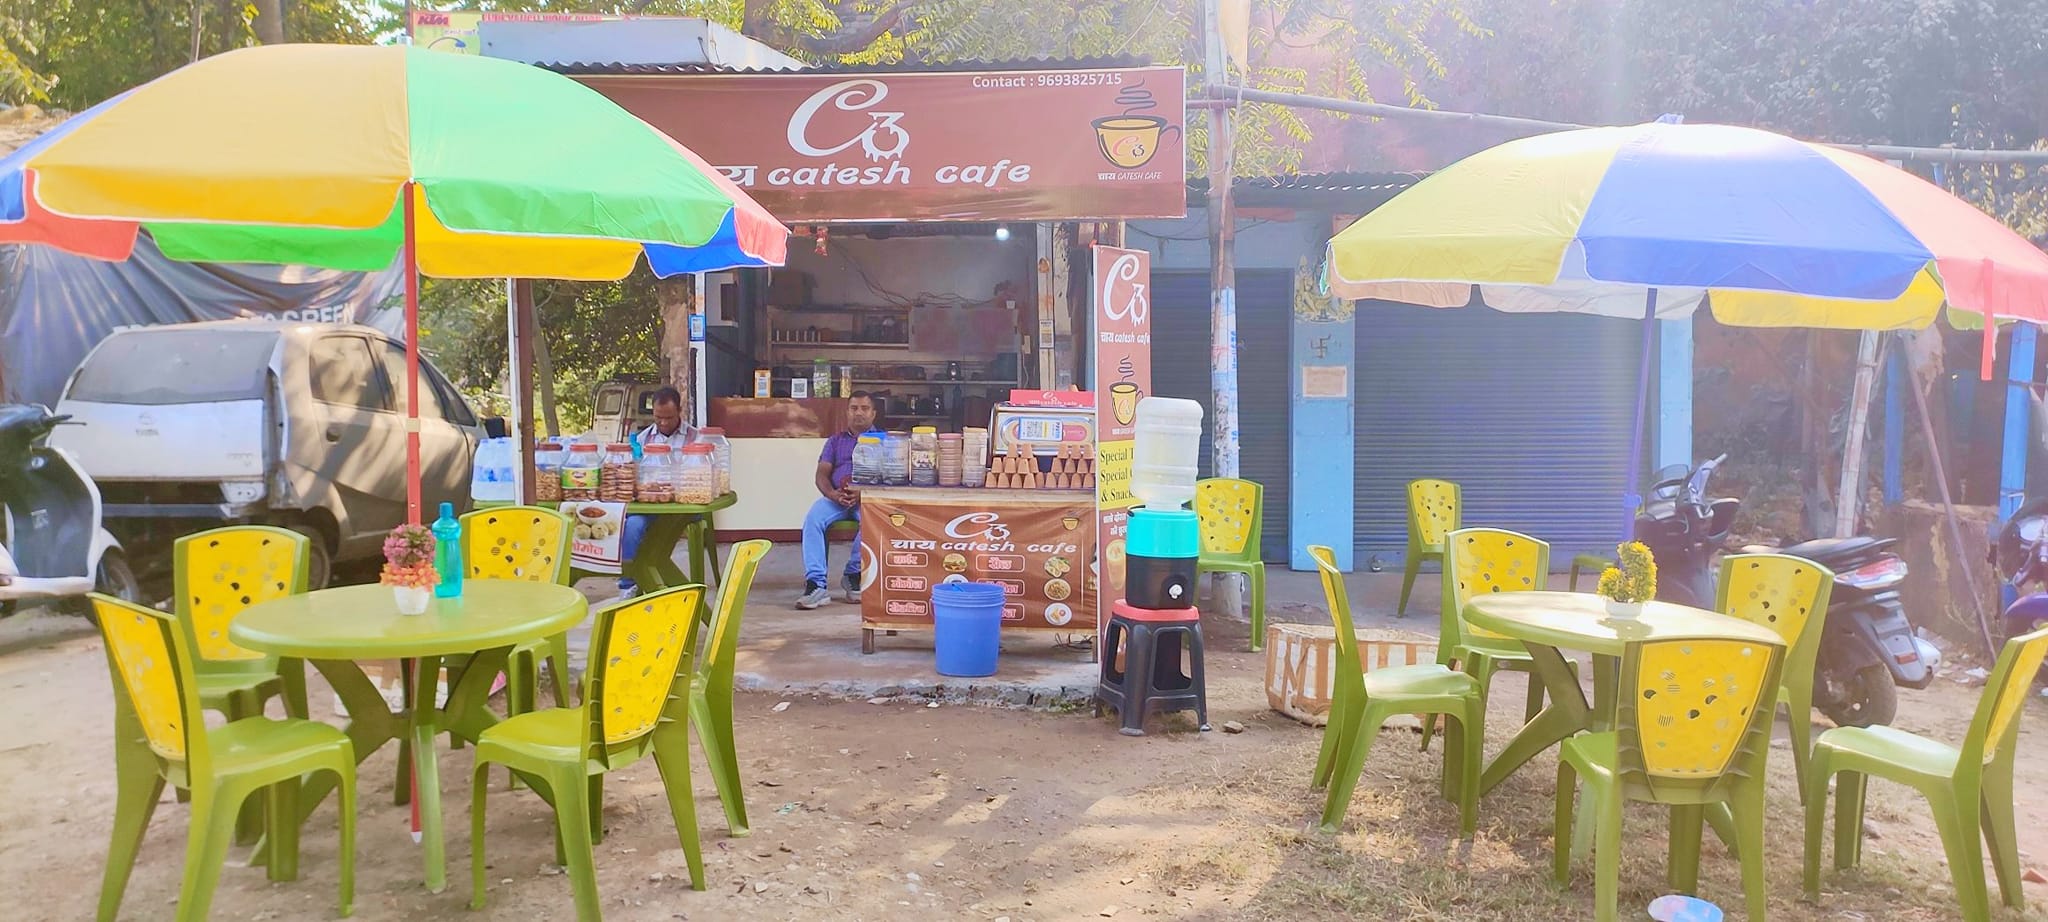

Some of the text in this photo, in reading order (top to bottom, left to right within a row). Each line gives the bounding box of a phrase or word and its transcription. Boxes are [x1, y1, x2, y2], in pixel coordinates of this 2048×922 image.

[417, 13, 449, 25] KTM
[972, 75, 1026, 88] Contact
[1037, 73, 1122, 86] 9693825715
[767, 161, 911, 186] catesh
[934, 160, 1031, 188] cafe
[1097, 171, 1162, 181] चाय CATESH CAFE
[1114, 331, 1136, 343] catesh
[1100, 447, 1128, 465] Special
[1100, 467, 1128, 485] Special
[1101, 489, 1108, 503] &
[890, 539, 1077, 554] चाय catesh cafe
